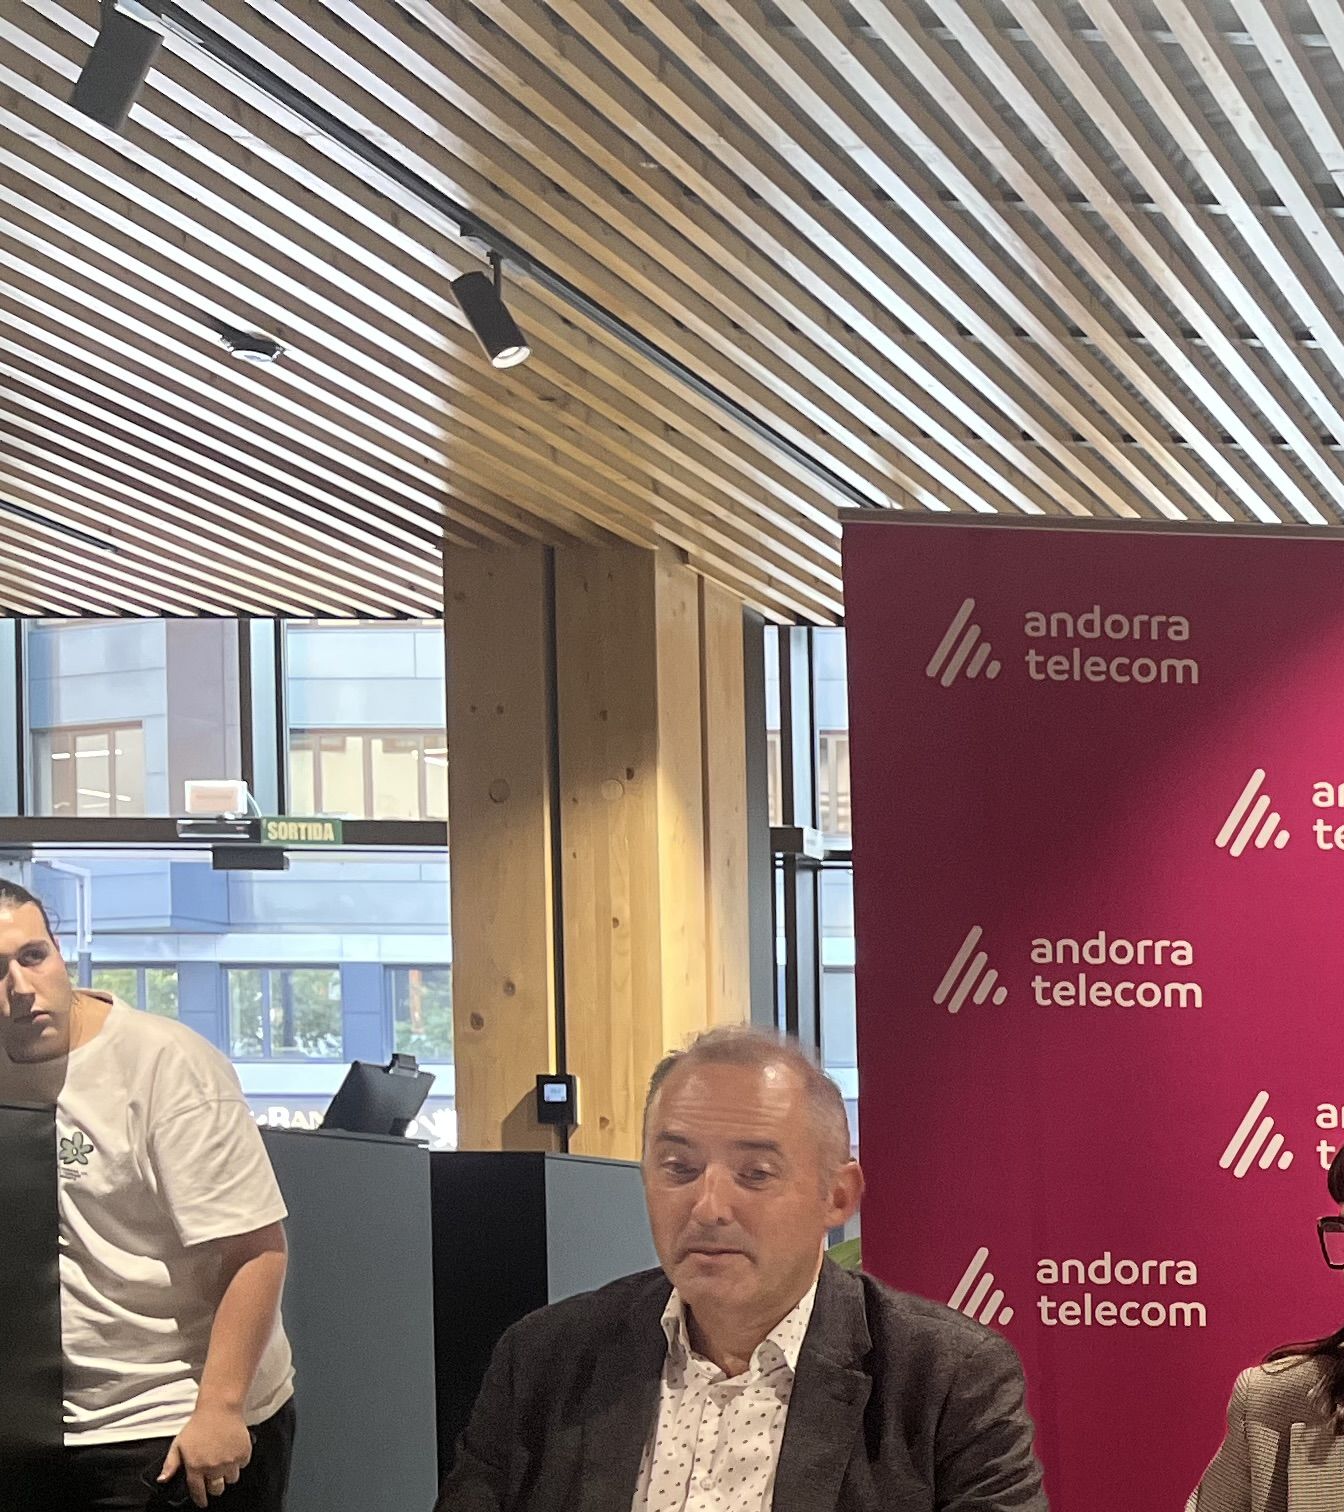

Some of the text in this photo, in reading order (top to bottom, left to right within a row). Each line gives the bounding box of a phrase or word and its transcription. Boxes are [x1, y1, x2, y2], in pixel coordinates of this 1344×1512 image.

[1025, 605, 1189, 641] andorra
[1025, 648, 1198, 684] telecom
[268, 822, 334, 840] SORTIDA
[1031, 931, 1193, 965] andorra
[1031, 973, 1202, 1008] telecom
[1037, 1252, 1197, 1285] andorra
[1037, 1293, 1206, 1326] telecom
